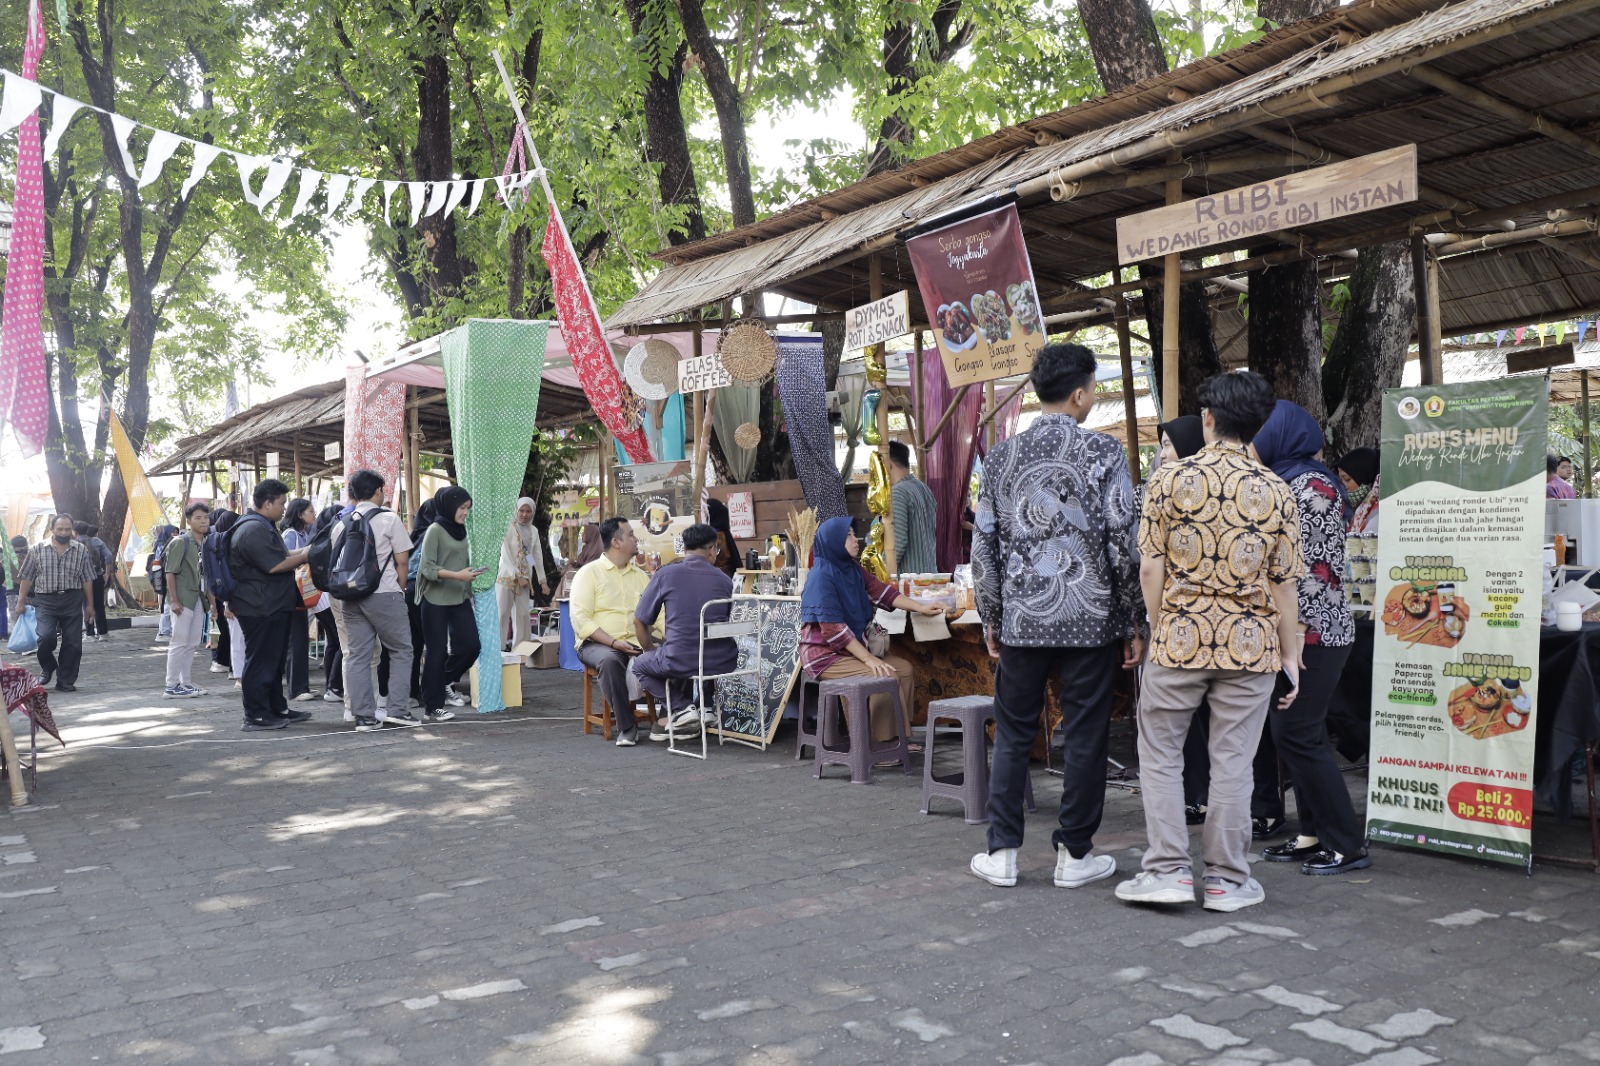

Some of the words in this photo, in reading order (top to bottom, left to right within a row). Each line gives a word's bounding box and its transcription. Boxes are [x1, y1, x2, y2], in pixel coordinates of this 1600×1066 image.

[1195, 179, 1288, 223] RUBI
[1126, 227, 1210, 258] WEDANG
[1217, 211, 1279, 241] RONDE
[1286, 201, 1319, 224] UBI
[1330, 180, 1404, 215] INSTAN
[855, 298, 894, 328] DYMAS
[848, 329, 866, 348] ROTI
[876, 313, 906, 341] SNACK
[988, 343, 1016, 359] Nasgor
[955, 359, 984, 376] Gongso
[990, 357, 1018, 375] Gongso
[1448, 397, 1479, 406] FAKULTAS
[1480, 395, 1516, 403] PERTANIAN
[1494, 400, 1534, 409] Yogyakarta
[1404, 430, 1463, 450] RUBI'S
[1465, 427, 1519, 447] MENU
[1398, 449, 1436, 470] Wedang
[1439, 447, 1468, 467] Ronde
[1470, 444, 1492, 465] Ubi
[1509, 496, 1529, 505] yang
[1405, 507, 1446, 516] dipadukan
[1448, 507, 1477, 516] dengan
[1479, 506, 1520, 514] kondimen
[1399, 517, 1435, 526] premium
[1454, 516, 1475, 524] kuah
[1475, 516, 1494, 525] jahe
[1496, 515, 1525, 524] hangat
[1422, 526, 1458, 534] disajikan
[1460, 525, 1486, 533] dalam
[1398, 535, 1424, 543] instan
[1425, 535, 1454, 544] dengan
[1473, 534, 1499, 542] varian
[1404, 556, 1453, 568] VARIAN
[1389, 566, 1468, 582] ORIGINAL
[1485, 570, 1517, 579] Dengan
[1483, 586, 1503, 594] isian
[1504, 586, 1525, 595] yaitu
[1488, 595, 1519, 604] kacang
[1494, 603, 1513, 612] gula
[1480, 611, 1508, 619] merah
[1509, 611, 1524, 619] dan
[1487, 619, 1518, 627] Cokelat
[1463, 653, 1514, 666] VARIAN
[1395, 662, 1433, 671] Kemasan
[1442, 662, 1485, 678] JAHE
[1486, 665, 1533, 682] SUSU
[1395, 670, 1433, 680] Papercup
[1408, 679, 1436, 687] sendok
[1392, 685, 1412, 694] kayu
[1413, 687, 1434, 696] yang
[1388, 693, 1438, 704] eco-friendly
[1375, 710, 1415, 722] Pelanggan
[1416, 714, 1444, 724] cerdas,
[1375, 719, 1392, 729] pilih
[1393, 720, 1426, 729] kemasan
[1427, 724, 1445, 732] eco-
[1394, 729, 1425, 739] friendly
[1377, 756, 1417, 768] JANGAN
[1418, 759, 1454, 772] SAMPAI
[1456, 766, 1518, 781] KELEWATAN
[1378, 776, 1440, 795] KHUSUS
[1371, 791, 1411, 808] HARI
[1414, 797, 1445, 813] INI!
[1476, 789, 1502, 804] Beli
[1504, 793, 1513, 806] 2
[1458, 802, 1475, 818] Rp
[1477, 804, 1531, 825] 25.000,-
